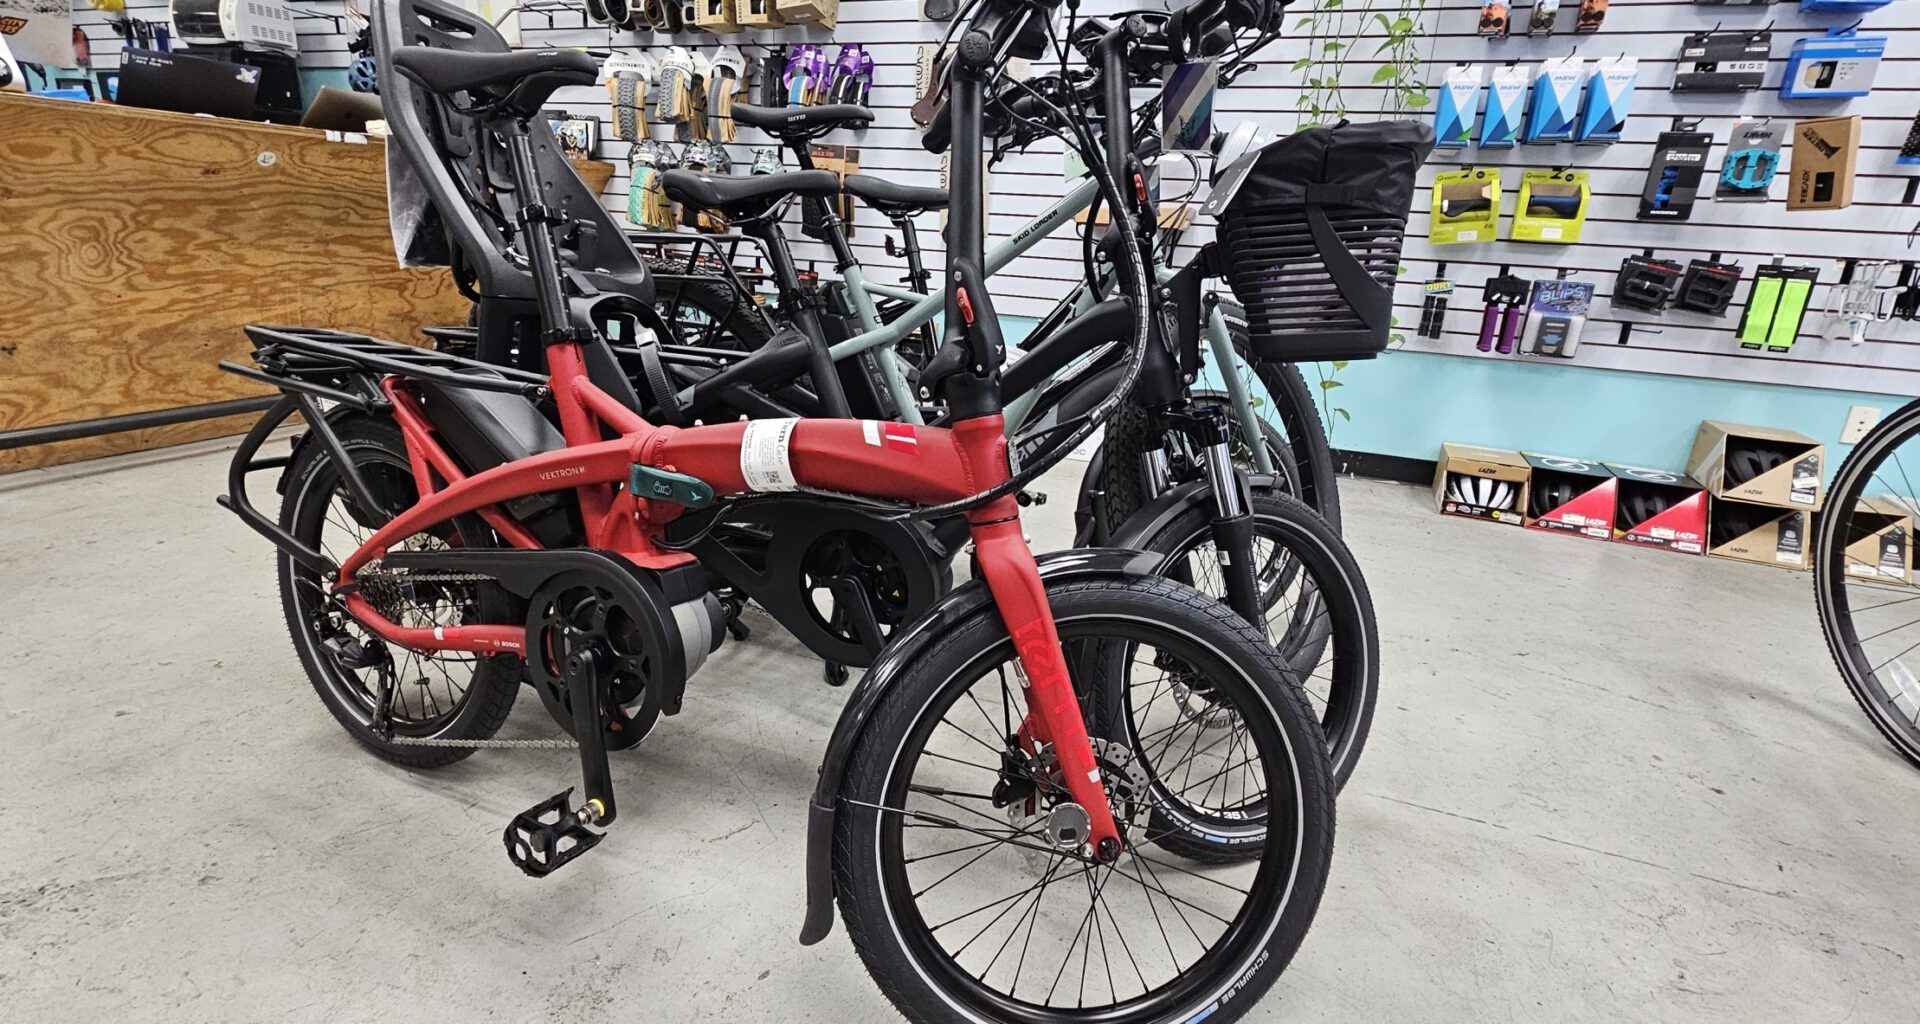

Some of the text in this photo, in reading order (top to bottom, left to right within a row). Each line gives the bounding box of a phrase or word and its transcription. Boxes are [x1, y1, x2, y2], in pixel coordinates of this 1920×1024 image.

[1012, 229, 1030, 245] SKID
[1540, 286, 1585, 303] BLIPS
[539, 467, 579, 480] VEKTRON
[1478, 467, 1497, 475] LAZER
[501, 640, 521, 649] BOSCH
[1221, 949, 1270, 1005] SCHWALBE
